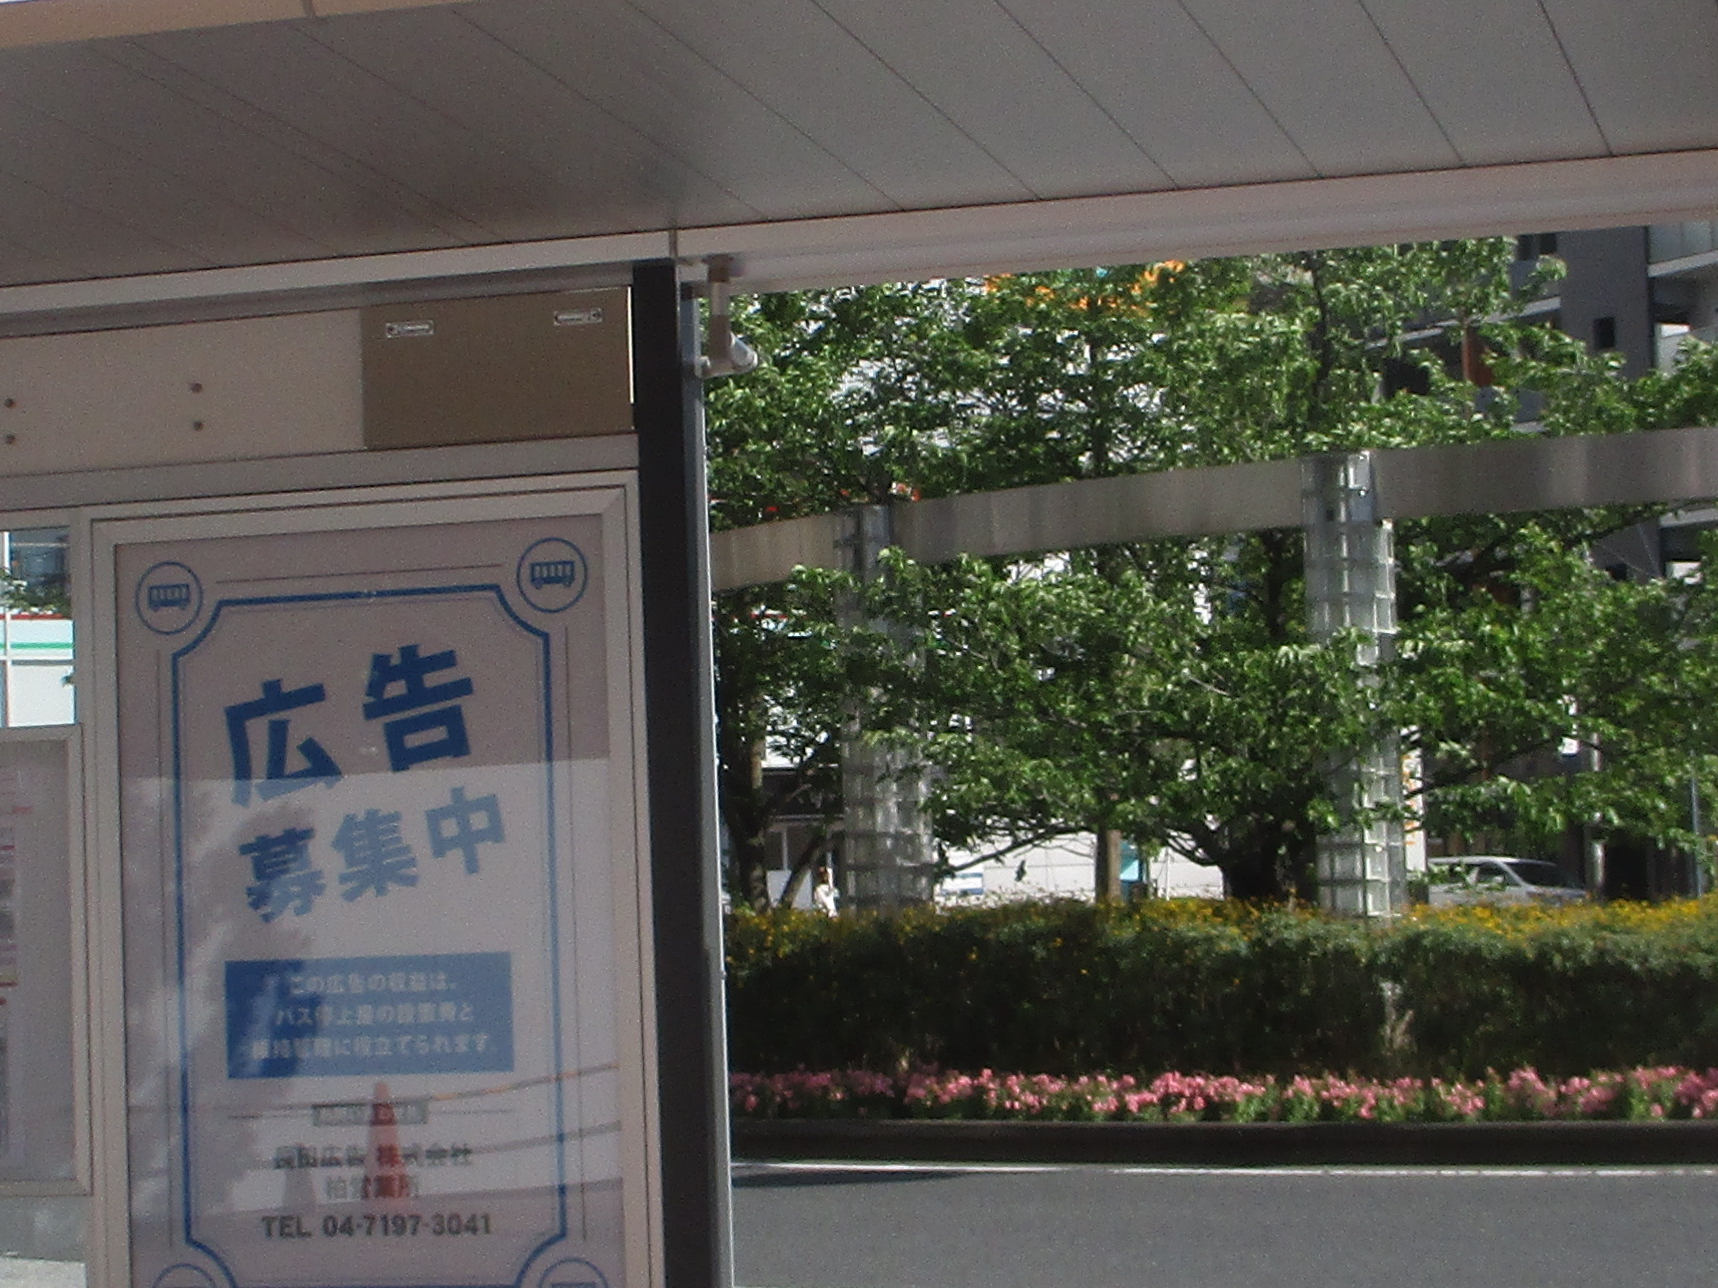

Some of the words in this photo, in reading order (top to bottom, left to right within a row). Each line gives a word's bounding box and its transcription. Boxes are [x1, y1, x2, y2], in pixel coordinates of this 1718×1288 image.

[224, 644, 475, 809] 広告
[238, 786, 507, 925] 募集中
[261, 1214, 312, 1239] TEL
[322, 1212, 492, 1238] 04-7197-3041
